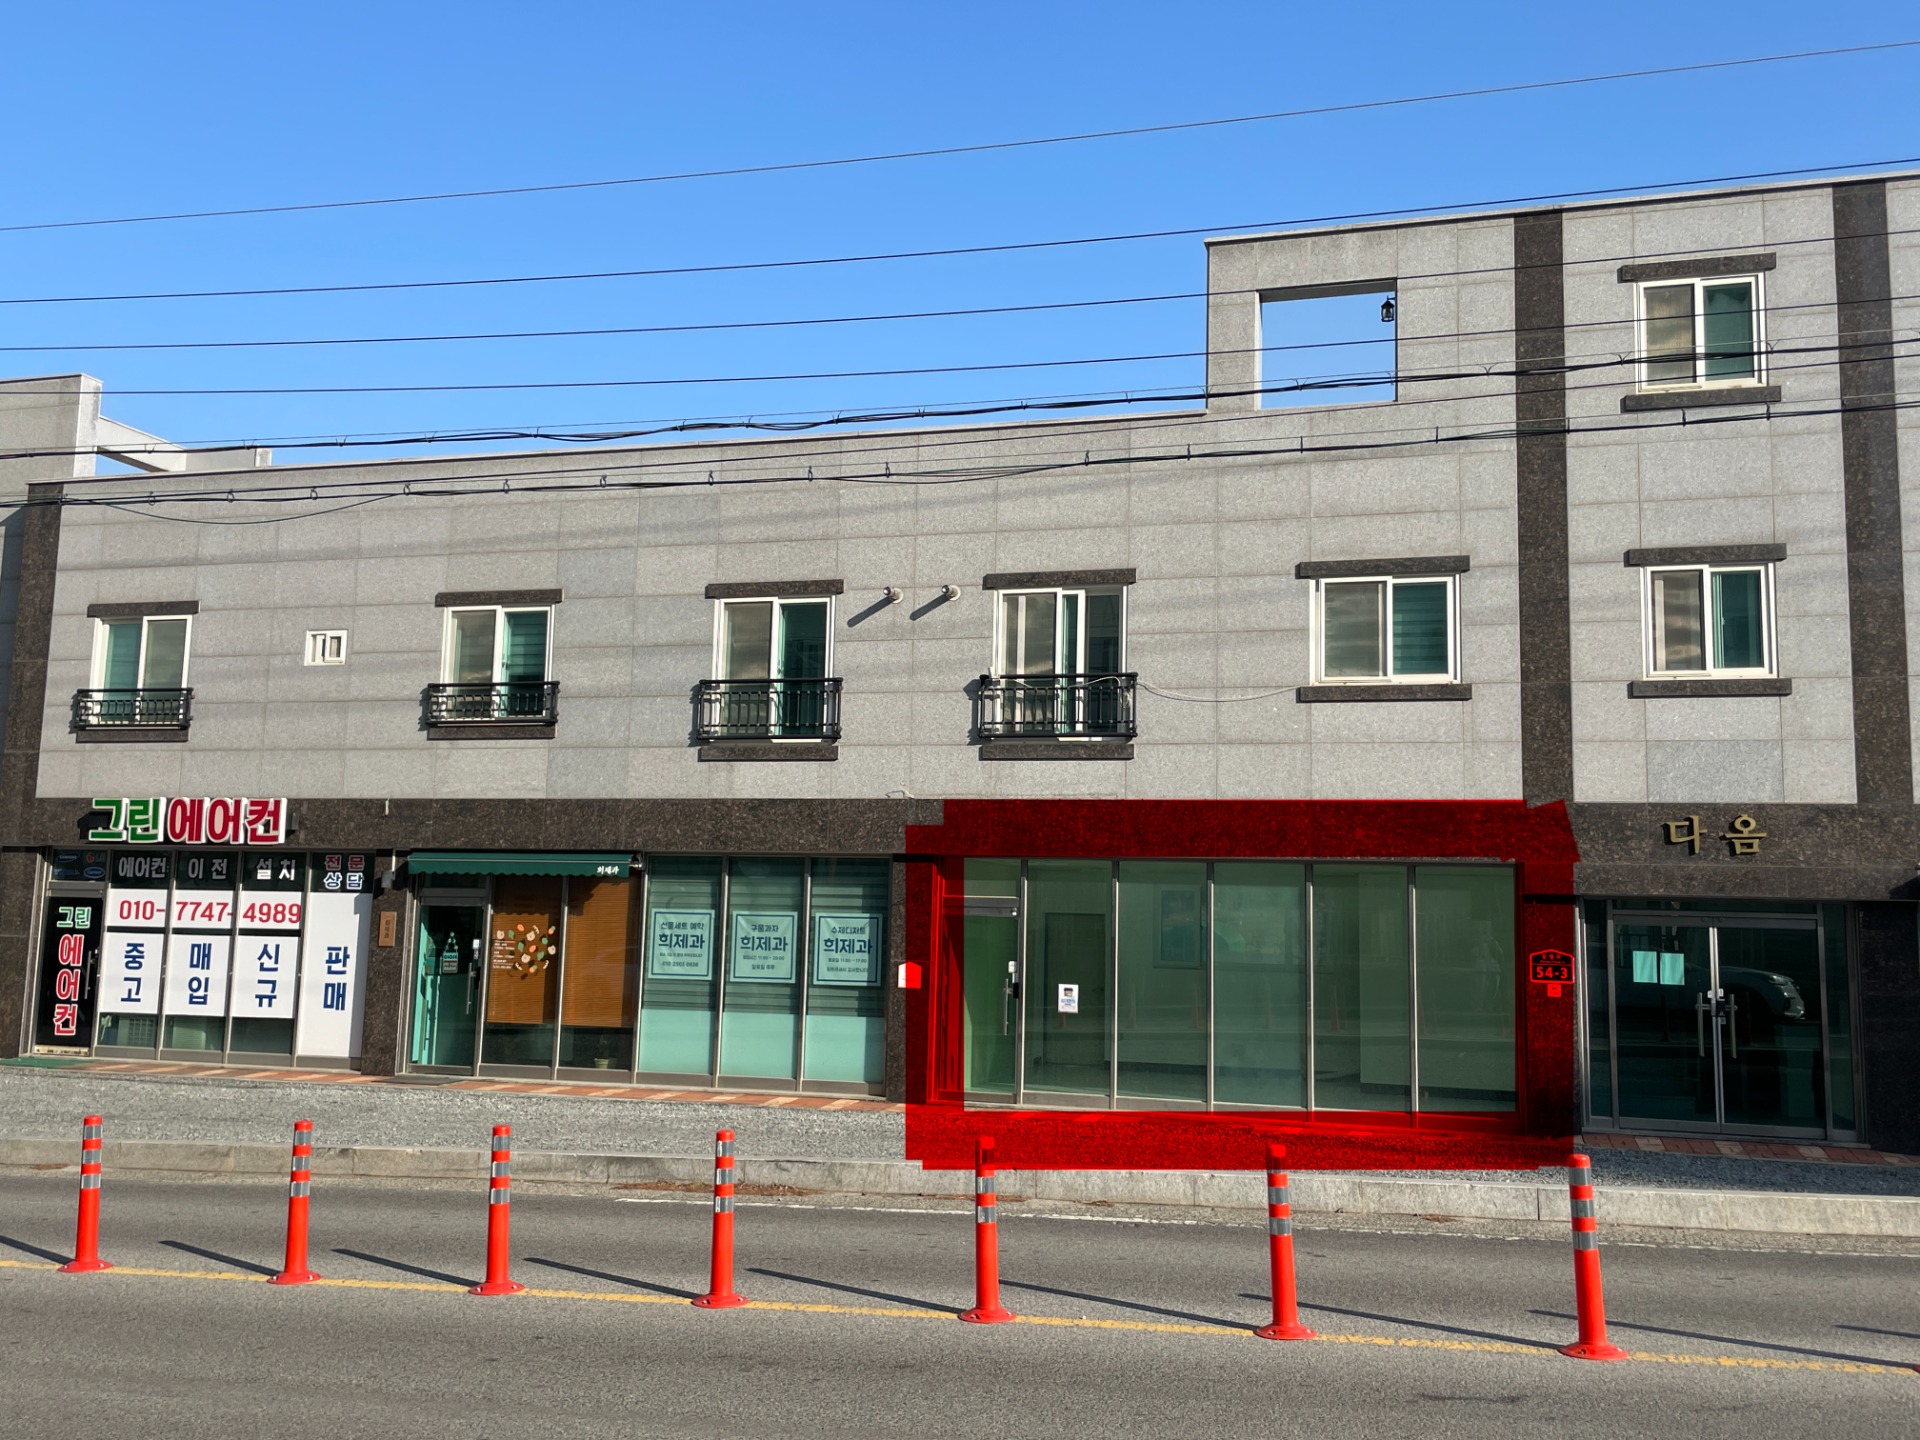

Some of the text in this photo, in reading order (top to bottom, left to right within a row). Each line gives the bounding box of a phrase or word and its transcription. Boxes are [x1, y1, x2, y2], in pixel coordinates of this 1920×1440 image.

[118, 857, 167, 879] 에어컨
[256, 858, 296, 881] 설치
[324, 872, 365, 889] 상담
[56, 907, 92, 928] 그린
[243, 902, 301, 924] 4989
[658, 933, 706, 949] 희제과
[740, 935, 788, 952] 희제과
[823, 938, 873, 954] 희제과
[1536, 966, 1568, 979] 54-3
[53, 934, 85, 1036] 에어컨
